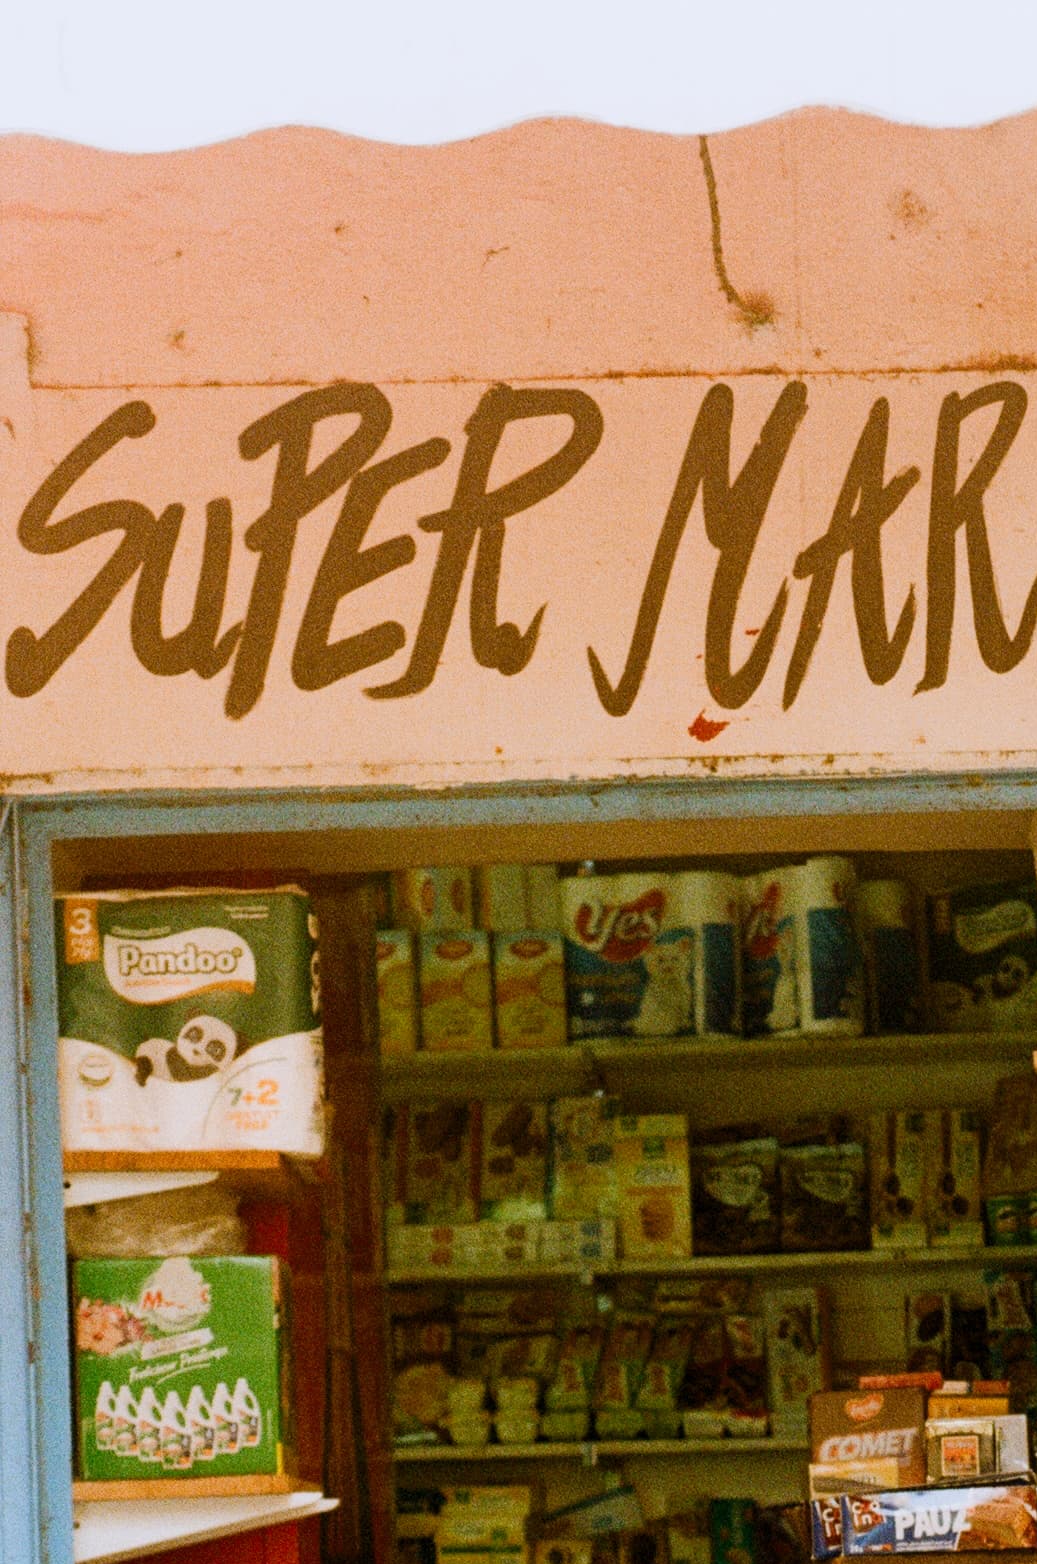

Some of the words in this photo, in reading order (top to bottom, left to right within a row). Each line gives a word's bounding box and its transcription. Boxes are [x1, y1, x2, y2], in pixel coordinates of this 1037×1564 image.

[69, 907, 93, 935] 3
[118, 943, 237, 977] Pandoo
[818, 1427, 918, 1463] COMET
[895, 1504, 972, 1540] PAUZ
